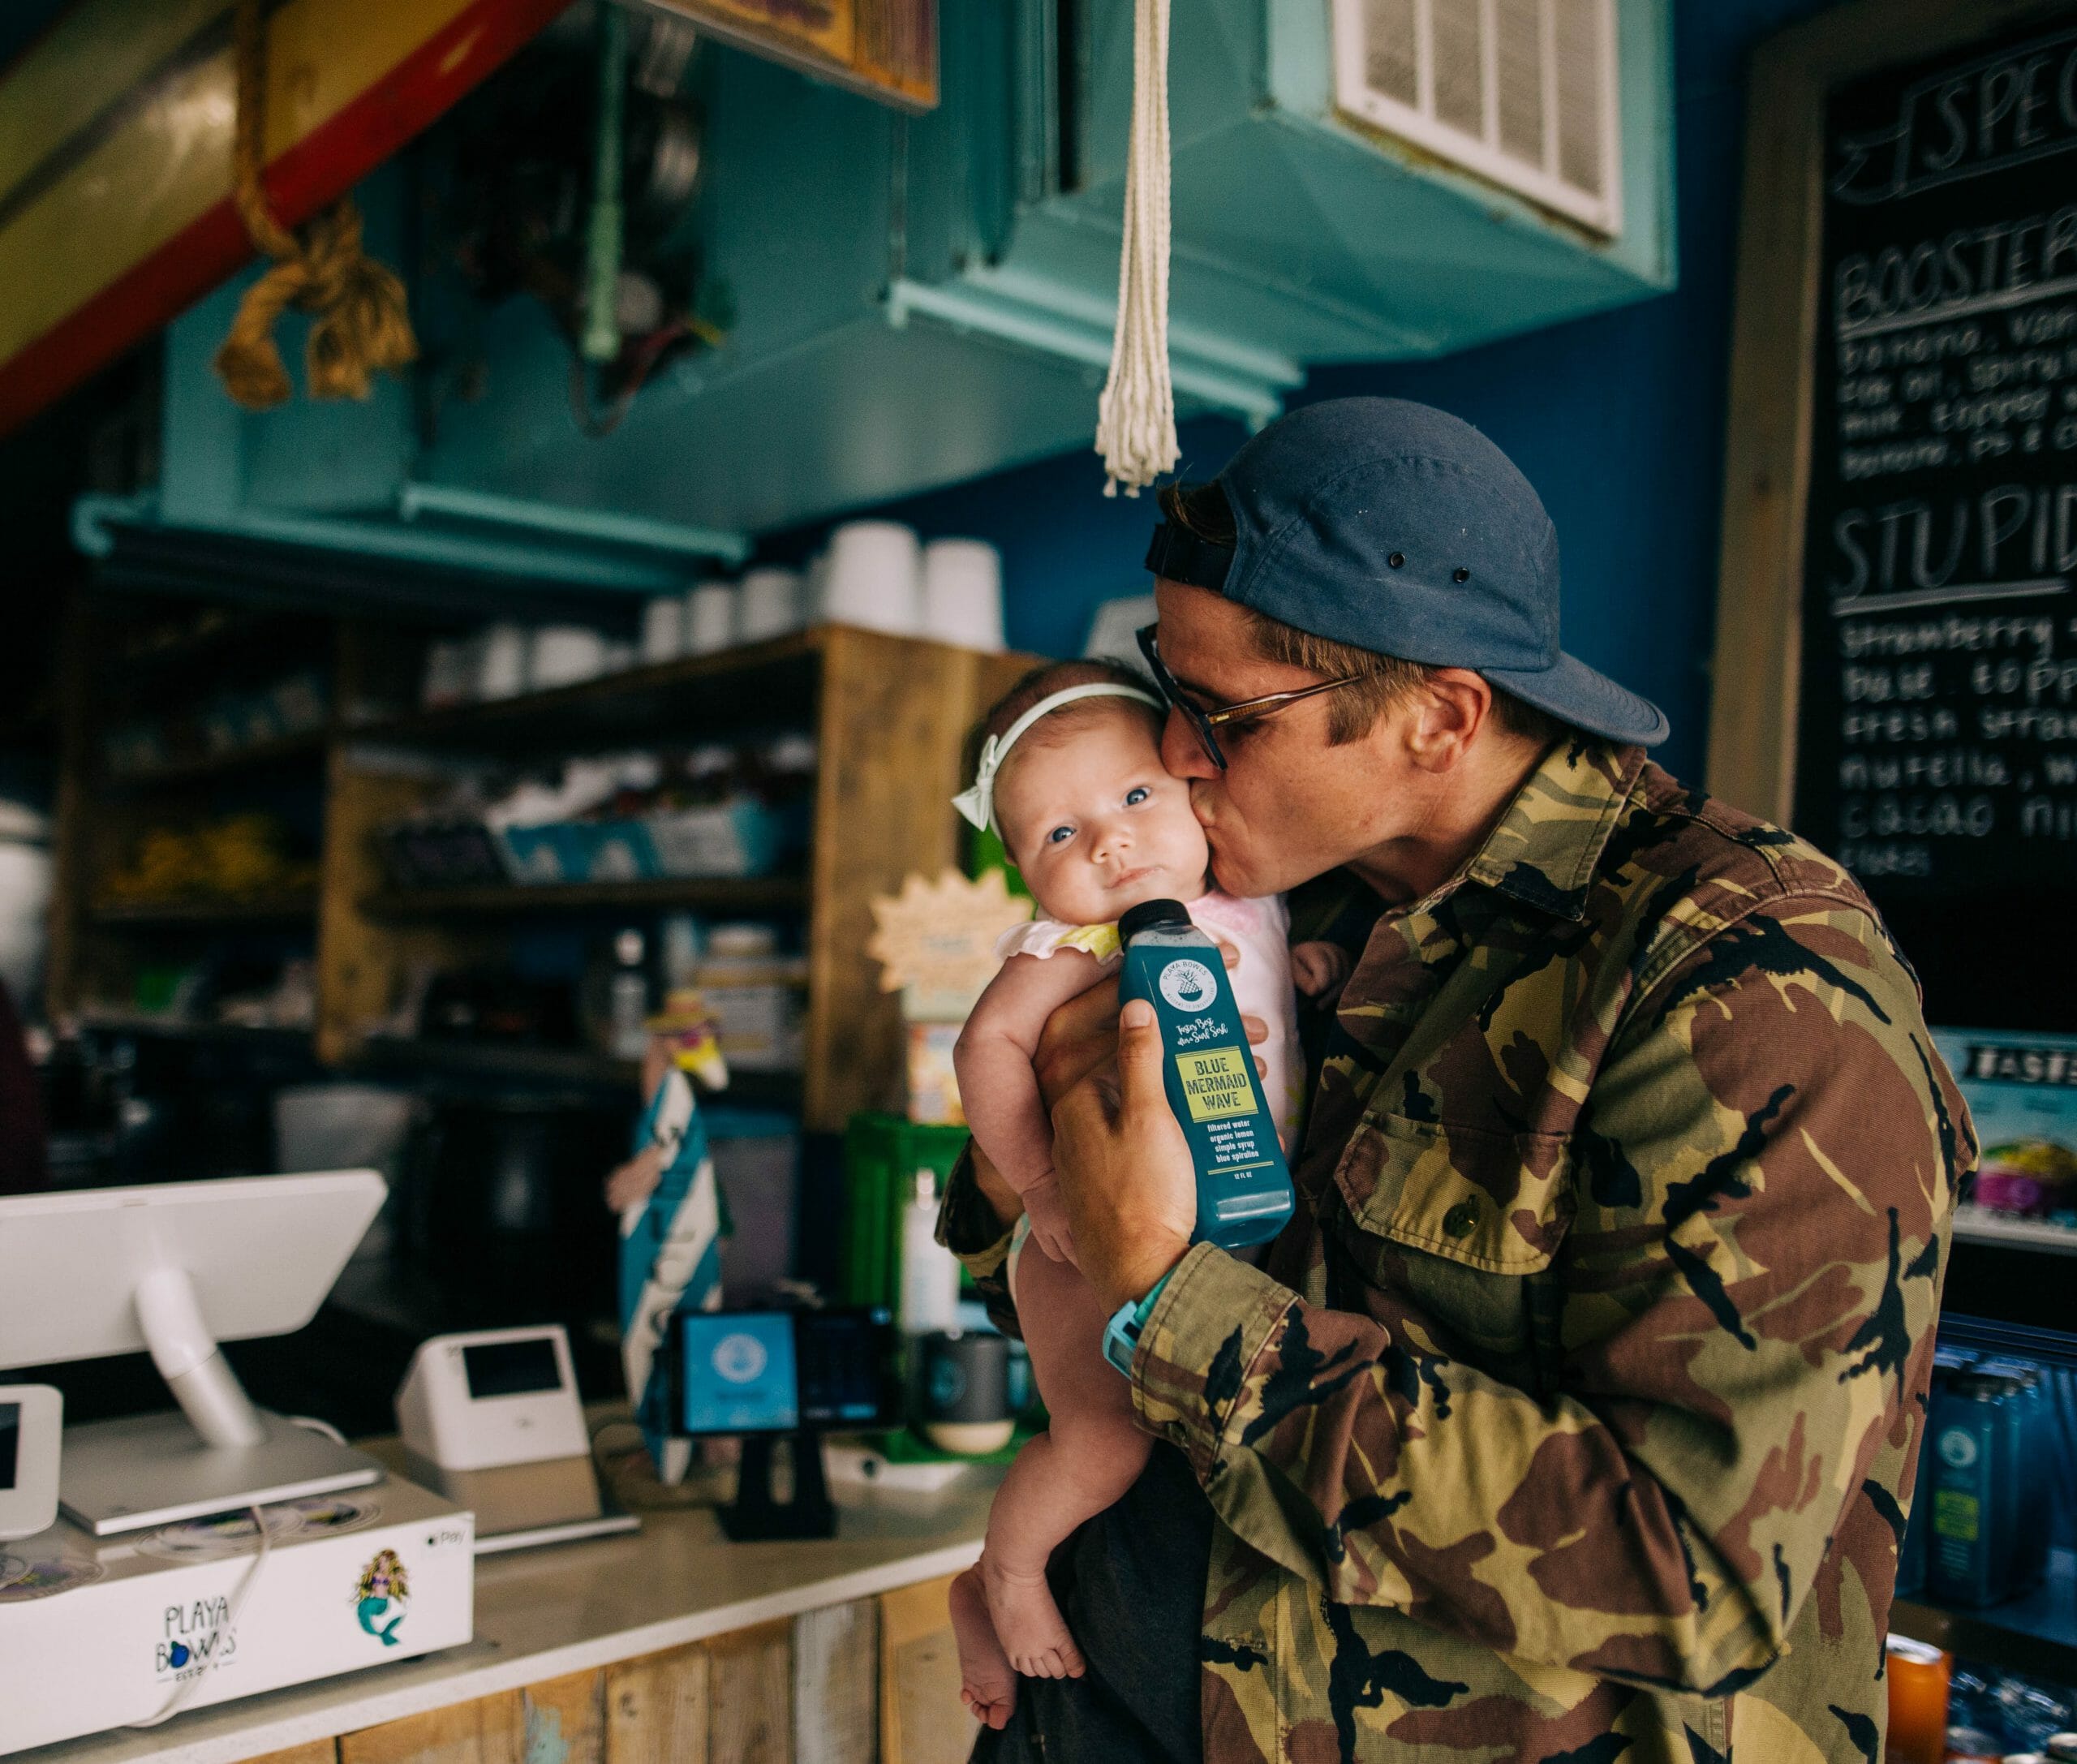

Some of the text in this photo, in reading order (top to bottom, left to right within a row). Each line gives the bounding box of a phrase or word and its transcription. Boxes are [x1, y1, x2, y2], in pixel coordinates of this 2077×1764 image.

[1829, 484, 2077, 600] STUPID
[1163, 961, 1208, 981] PLAYA BOWLS
[1176, 1018, 1215, 1036] Tastes Best
[1191, 1030, 1211, 1043] Surf
[1209, 1022, 1228, 1038] Sesh
[1194, 1056, 1230, 1076] BLUE
[1185, 1073, 1248, 1095] MERMAID
[1202, 1091, 1241, 1111] WAVE
[1206, 1120, 1250, 1133] filtered water
[1210, 1130, 1254, 1144] organic lemon
[1215, 1140, 1255, 1154] simple syrup
[1215, 1151, 1259, 1164] blue spirulina
[165, 1596, 229, 1637] PLAYA
